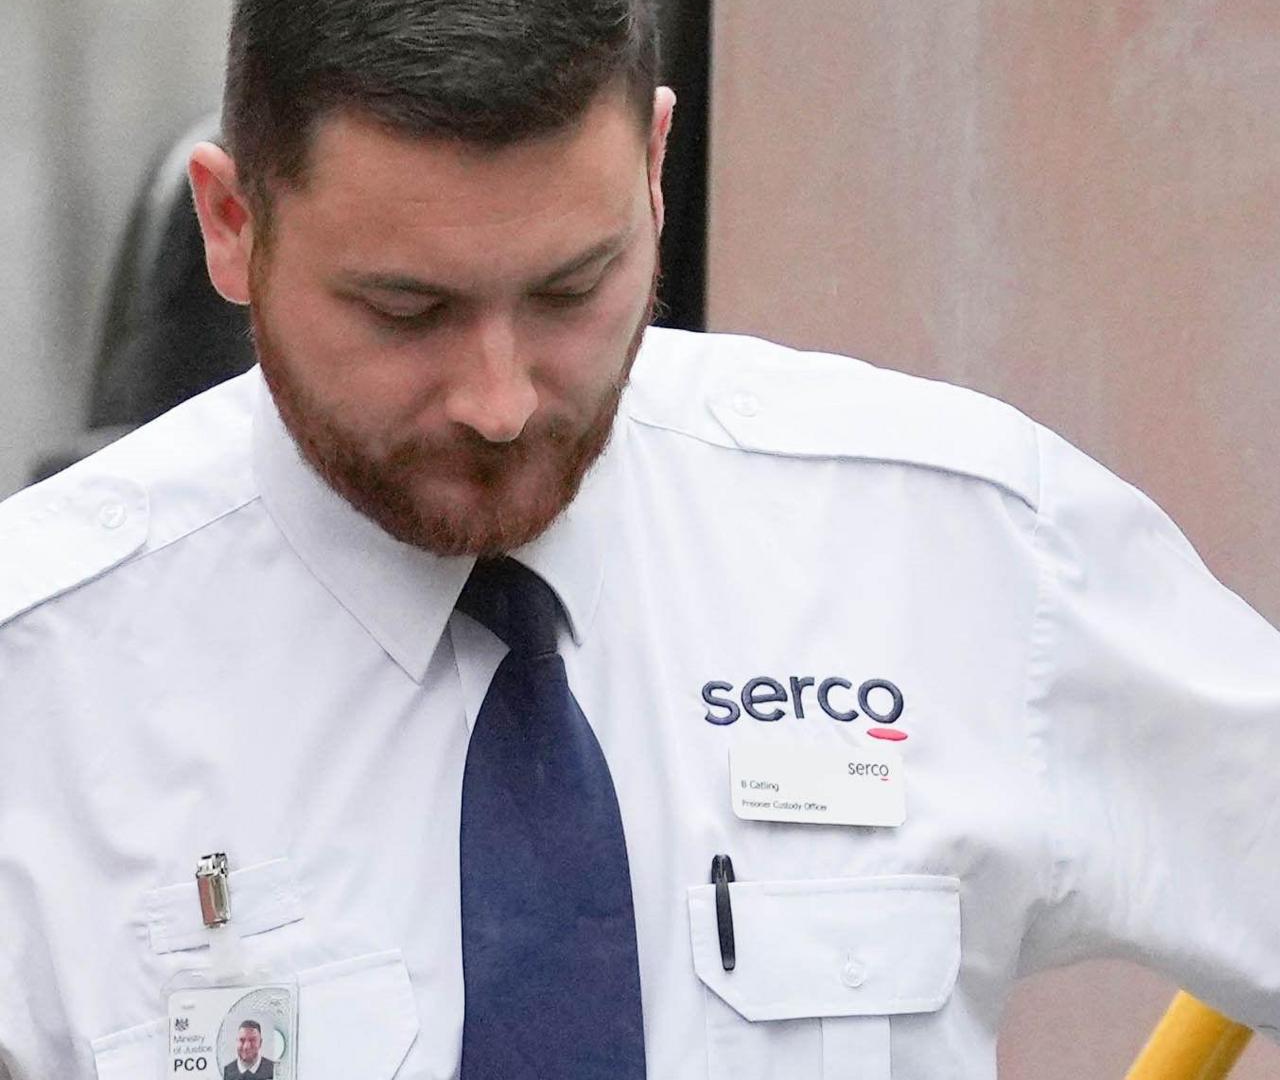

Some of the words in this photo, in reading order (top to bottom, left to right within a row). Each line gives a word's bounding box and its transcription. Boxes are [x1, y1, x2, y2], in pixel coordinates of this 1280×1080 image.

[701, 676, 904, 725] serco
[848, 761, 889, 777] serco
[773, 800, 802, 810] Custody
[174, 1057, 207, 1072] PCO
